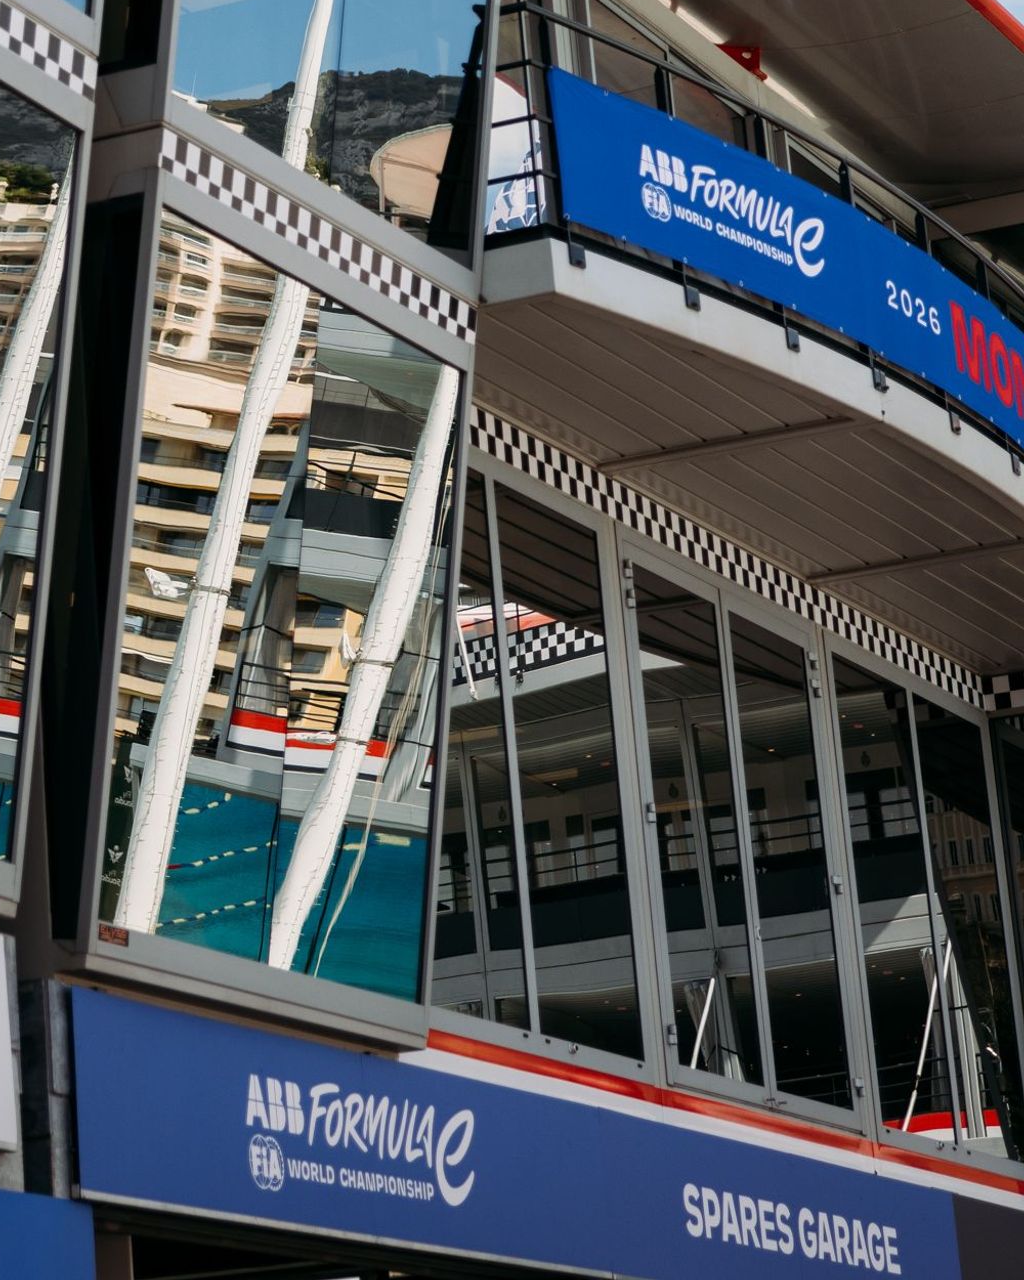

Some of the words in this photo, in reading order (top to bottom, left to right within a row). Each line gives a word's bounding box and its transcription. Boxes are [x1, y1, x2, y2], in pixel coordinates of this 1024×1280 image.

[639, 144, 688, 193] ABB
[690, 165, 794, 247] FORMULA
[673, 204, 713, 231] WORLD
[716, 222, 794, 266] CHAMPIONSHIP
[885, 280, 941, 335] 2026
[246, 1074, 305, 1136] ABB
[308, 1082, 435, 1169] FORMULA
[287, 1158, 335, 1185] WORLD
[340, 1167, 435, 1202] CHAMPIONSHIP
[683, 1182, 795, 1255] SPARES
[798, 1207, 902, 1275] GARAGE
